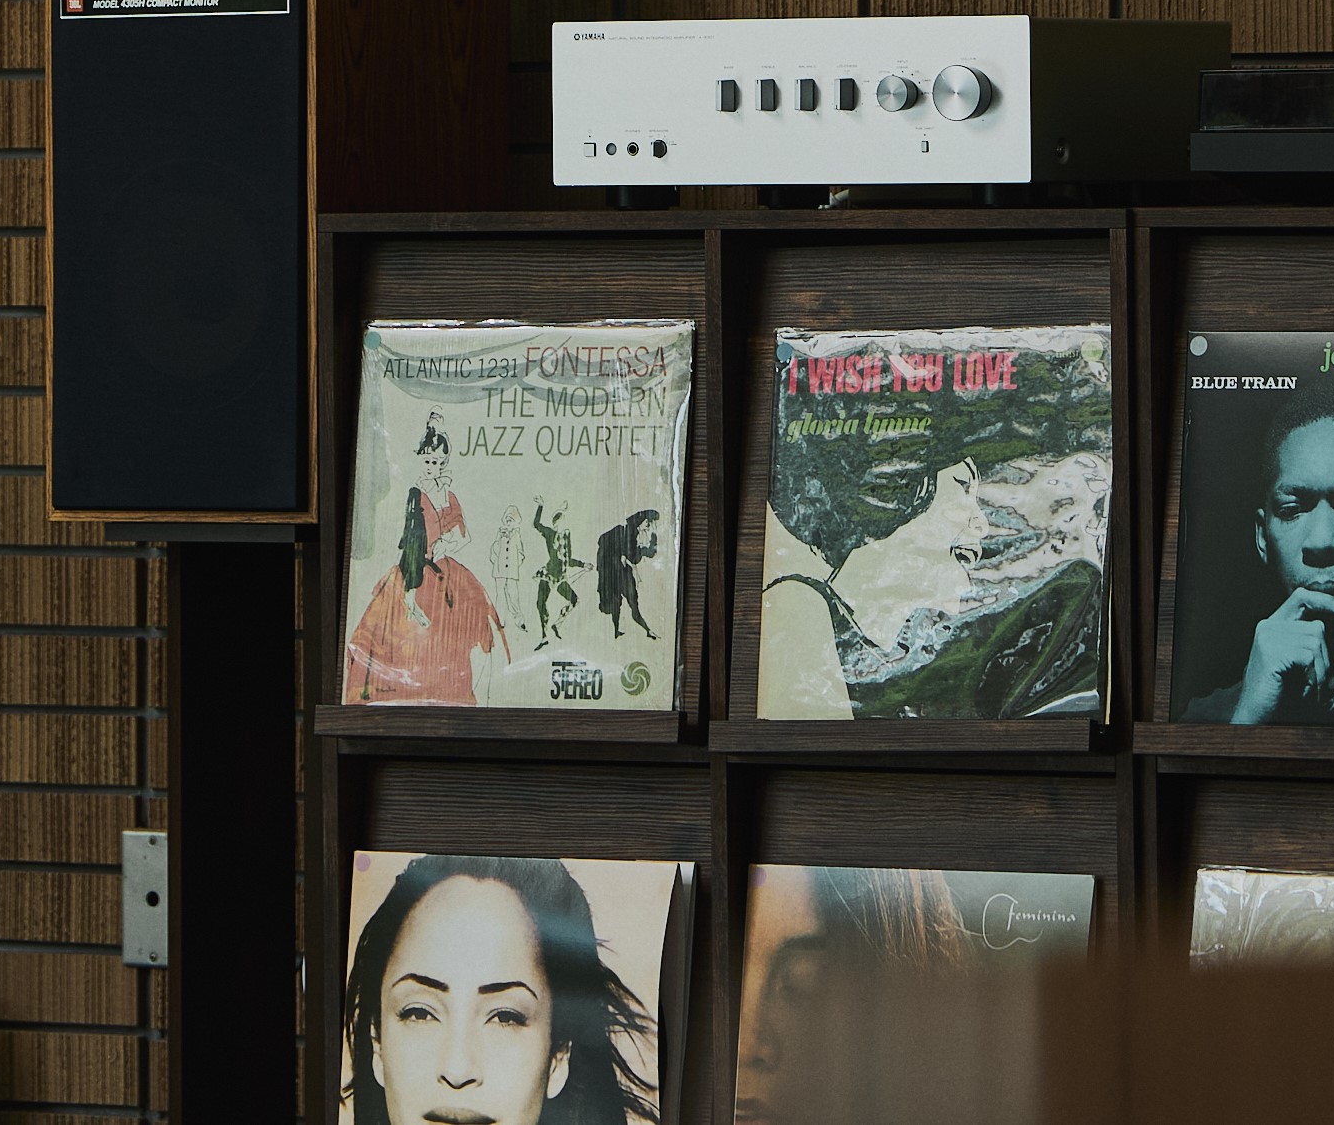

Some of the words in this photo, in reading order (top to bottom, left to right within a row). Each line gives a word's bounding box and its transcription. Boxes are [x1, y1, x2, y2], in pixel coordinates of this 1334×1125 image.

[69, 0, 82, 9] JBL
[92, 0, 119, 9] MODEL
[383, 358, 472, 378] ATLANTIC
[478, 358, 518, 378] 1231
[524, 346, 667, 377] FONTESSA
[788, 357, 799, 395] I
[808, 355, 883, 394] WISH
[889, 354, 943, 393] YOU
[953, 351, 1018, 391] LOVE
[1190, 377, 1237, 390] BLUE
[1242, 377, 1297, 390] TRAIN
[482, 387, 535, 418] THE
[545, 386, 666, 417] MODERN
[786, 409, 859, 443] gloria
[863, 410, 932, 443] lynne
[459, 426, 524, 456] JAZZ
[535, 426, 664, 462] QUARTET
[551, 661, 603, 700] STEREO
